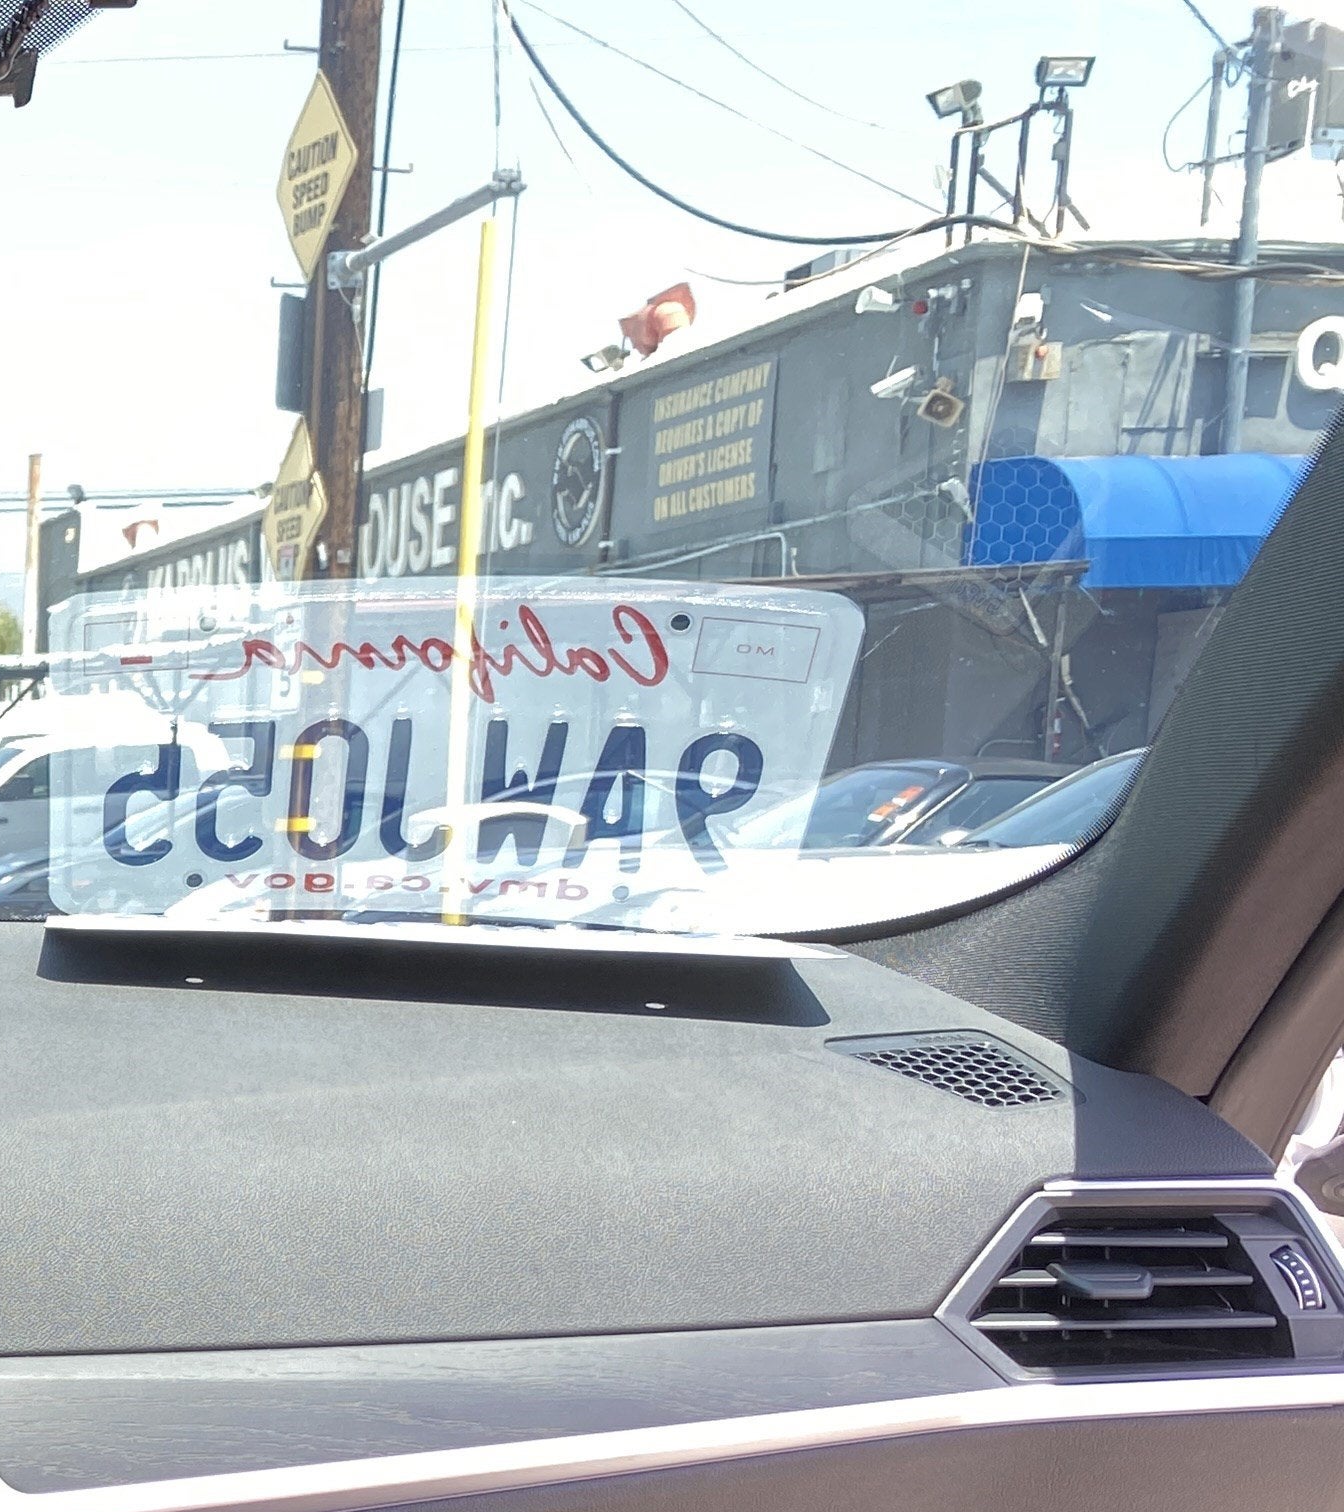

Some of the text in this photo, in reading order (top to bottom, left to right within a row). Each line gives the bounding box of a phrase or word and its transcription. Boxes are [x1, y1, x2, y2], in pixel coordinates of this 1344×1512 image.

[287, 131, 338, 180] CAUTION
[292, 172, 329, 210] SPEED
[293, 202, 326, 236] BUMP
[654, 362, 771, 423] INSURANCE COMPANY
[655, 398, 763, 455] REQUIRES A COPY OF
[659, 438, 753, 487] DRIVER'S LICENSE
[654, 472, 755, 522] ON ALL CUSTOMERS
